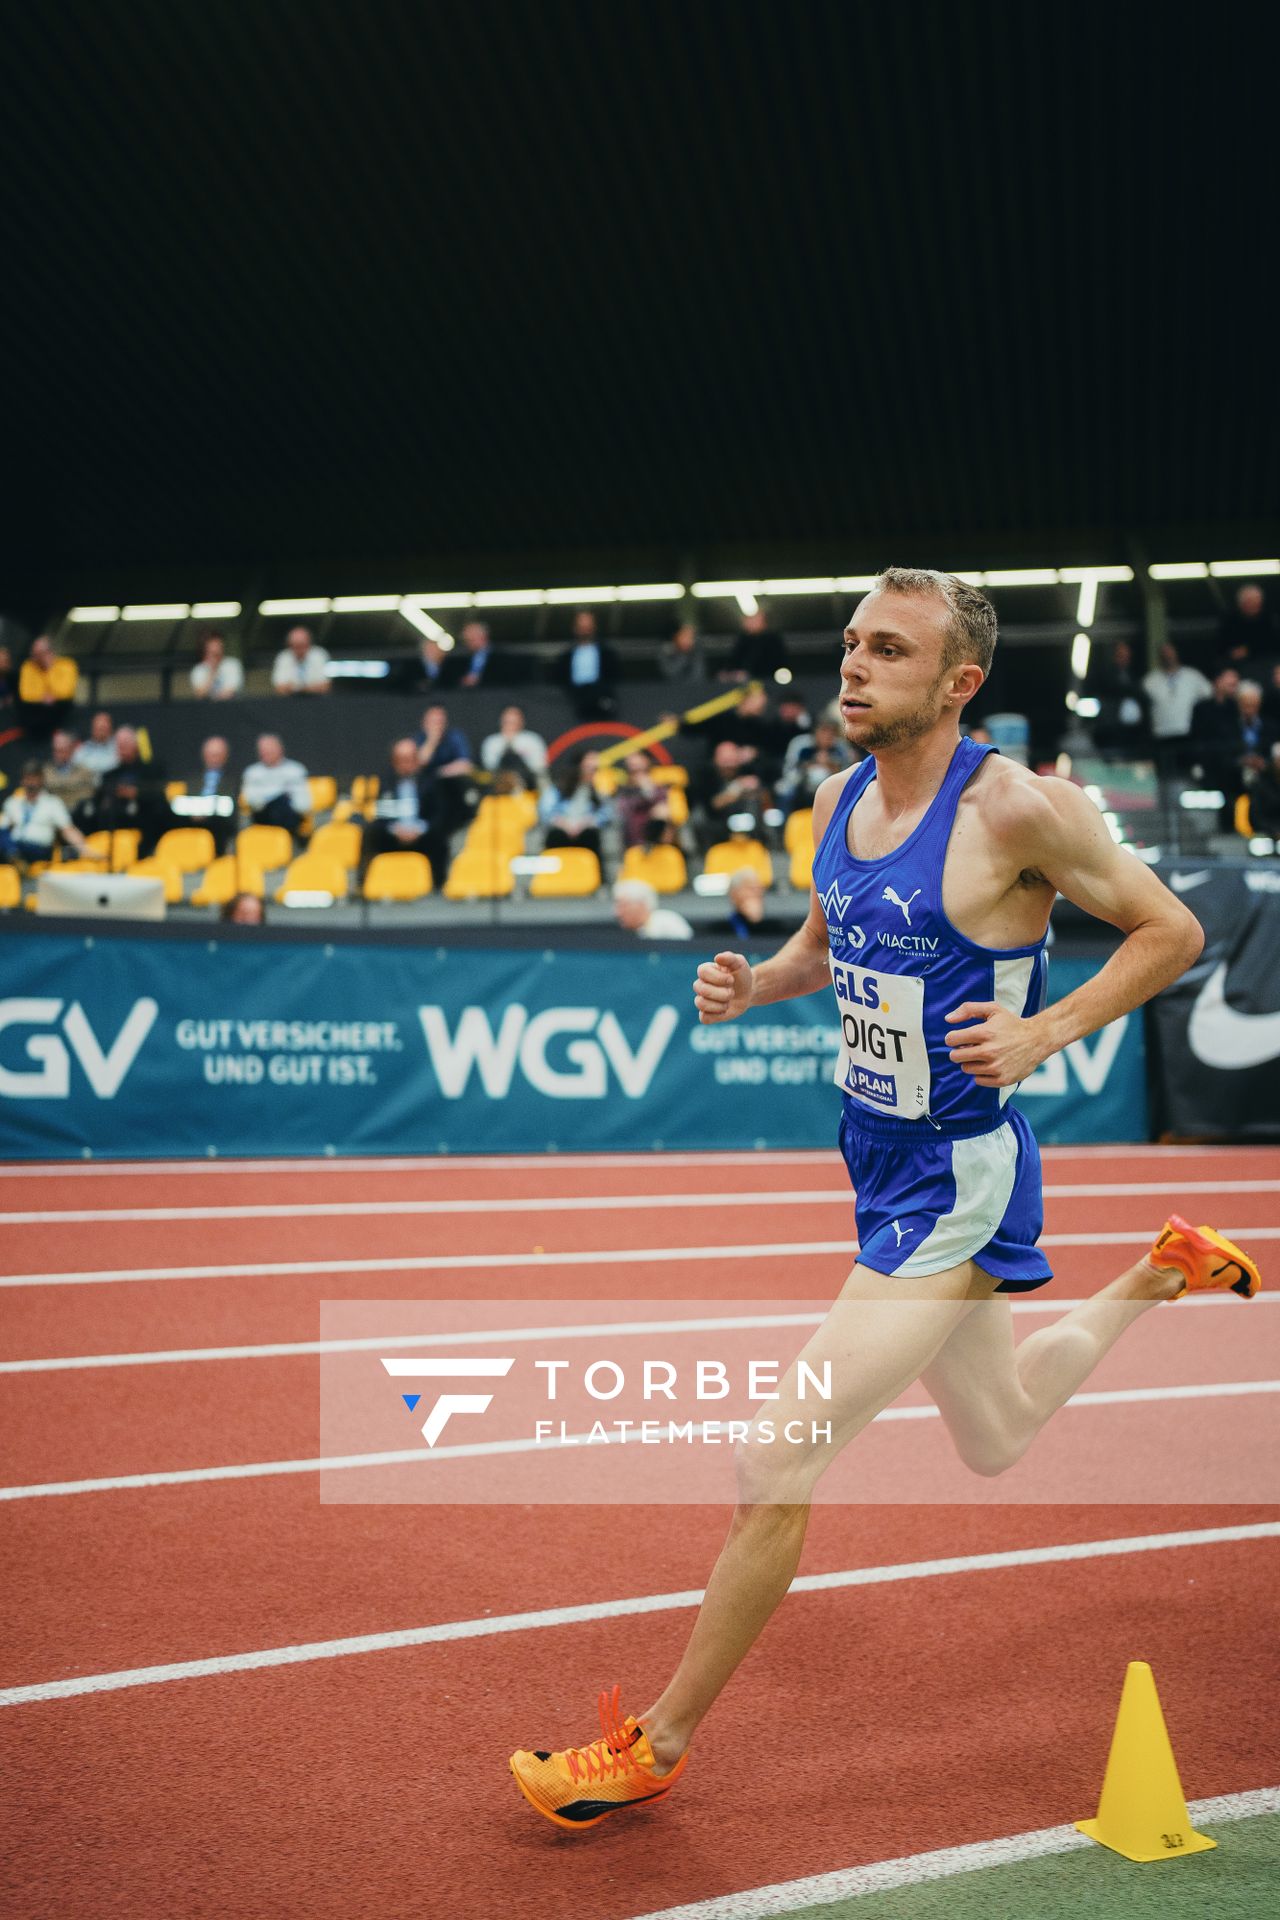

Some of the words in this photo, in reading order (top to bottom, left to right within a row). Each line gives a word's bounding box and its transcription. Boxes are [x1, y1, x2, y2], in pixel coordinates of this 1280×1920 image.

[876, 931, 939, 951] VIACTIV
[175, 1018, 232, 1050] GUT
[235, 1020, 404, 1052] VERSICHERT.
[418, 1002, 679, 1098] WGV
[690, 1024, 740, 1055] GUT
[203, 1054, 264, 1085] UND
[268, 1054, 324, 1085] GUT
[327, 1056, 378, 1086] IST.
[714, 1055, 769, 1085] UND
[769, 1055, 818, 1085] GUT
[858, 1071, 893, 1096] PLAN
[915, 1085, 925, 1107] 447
